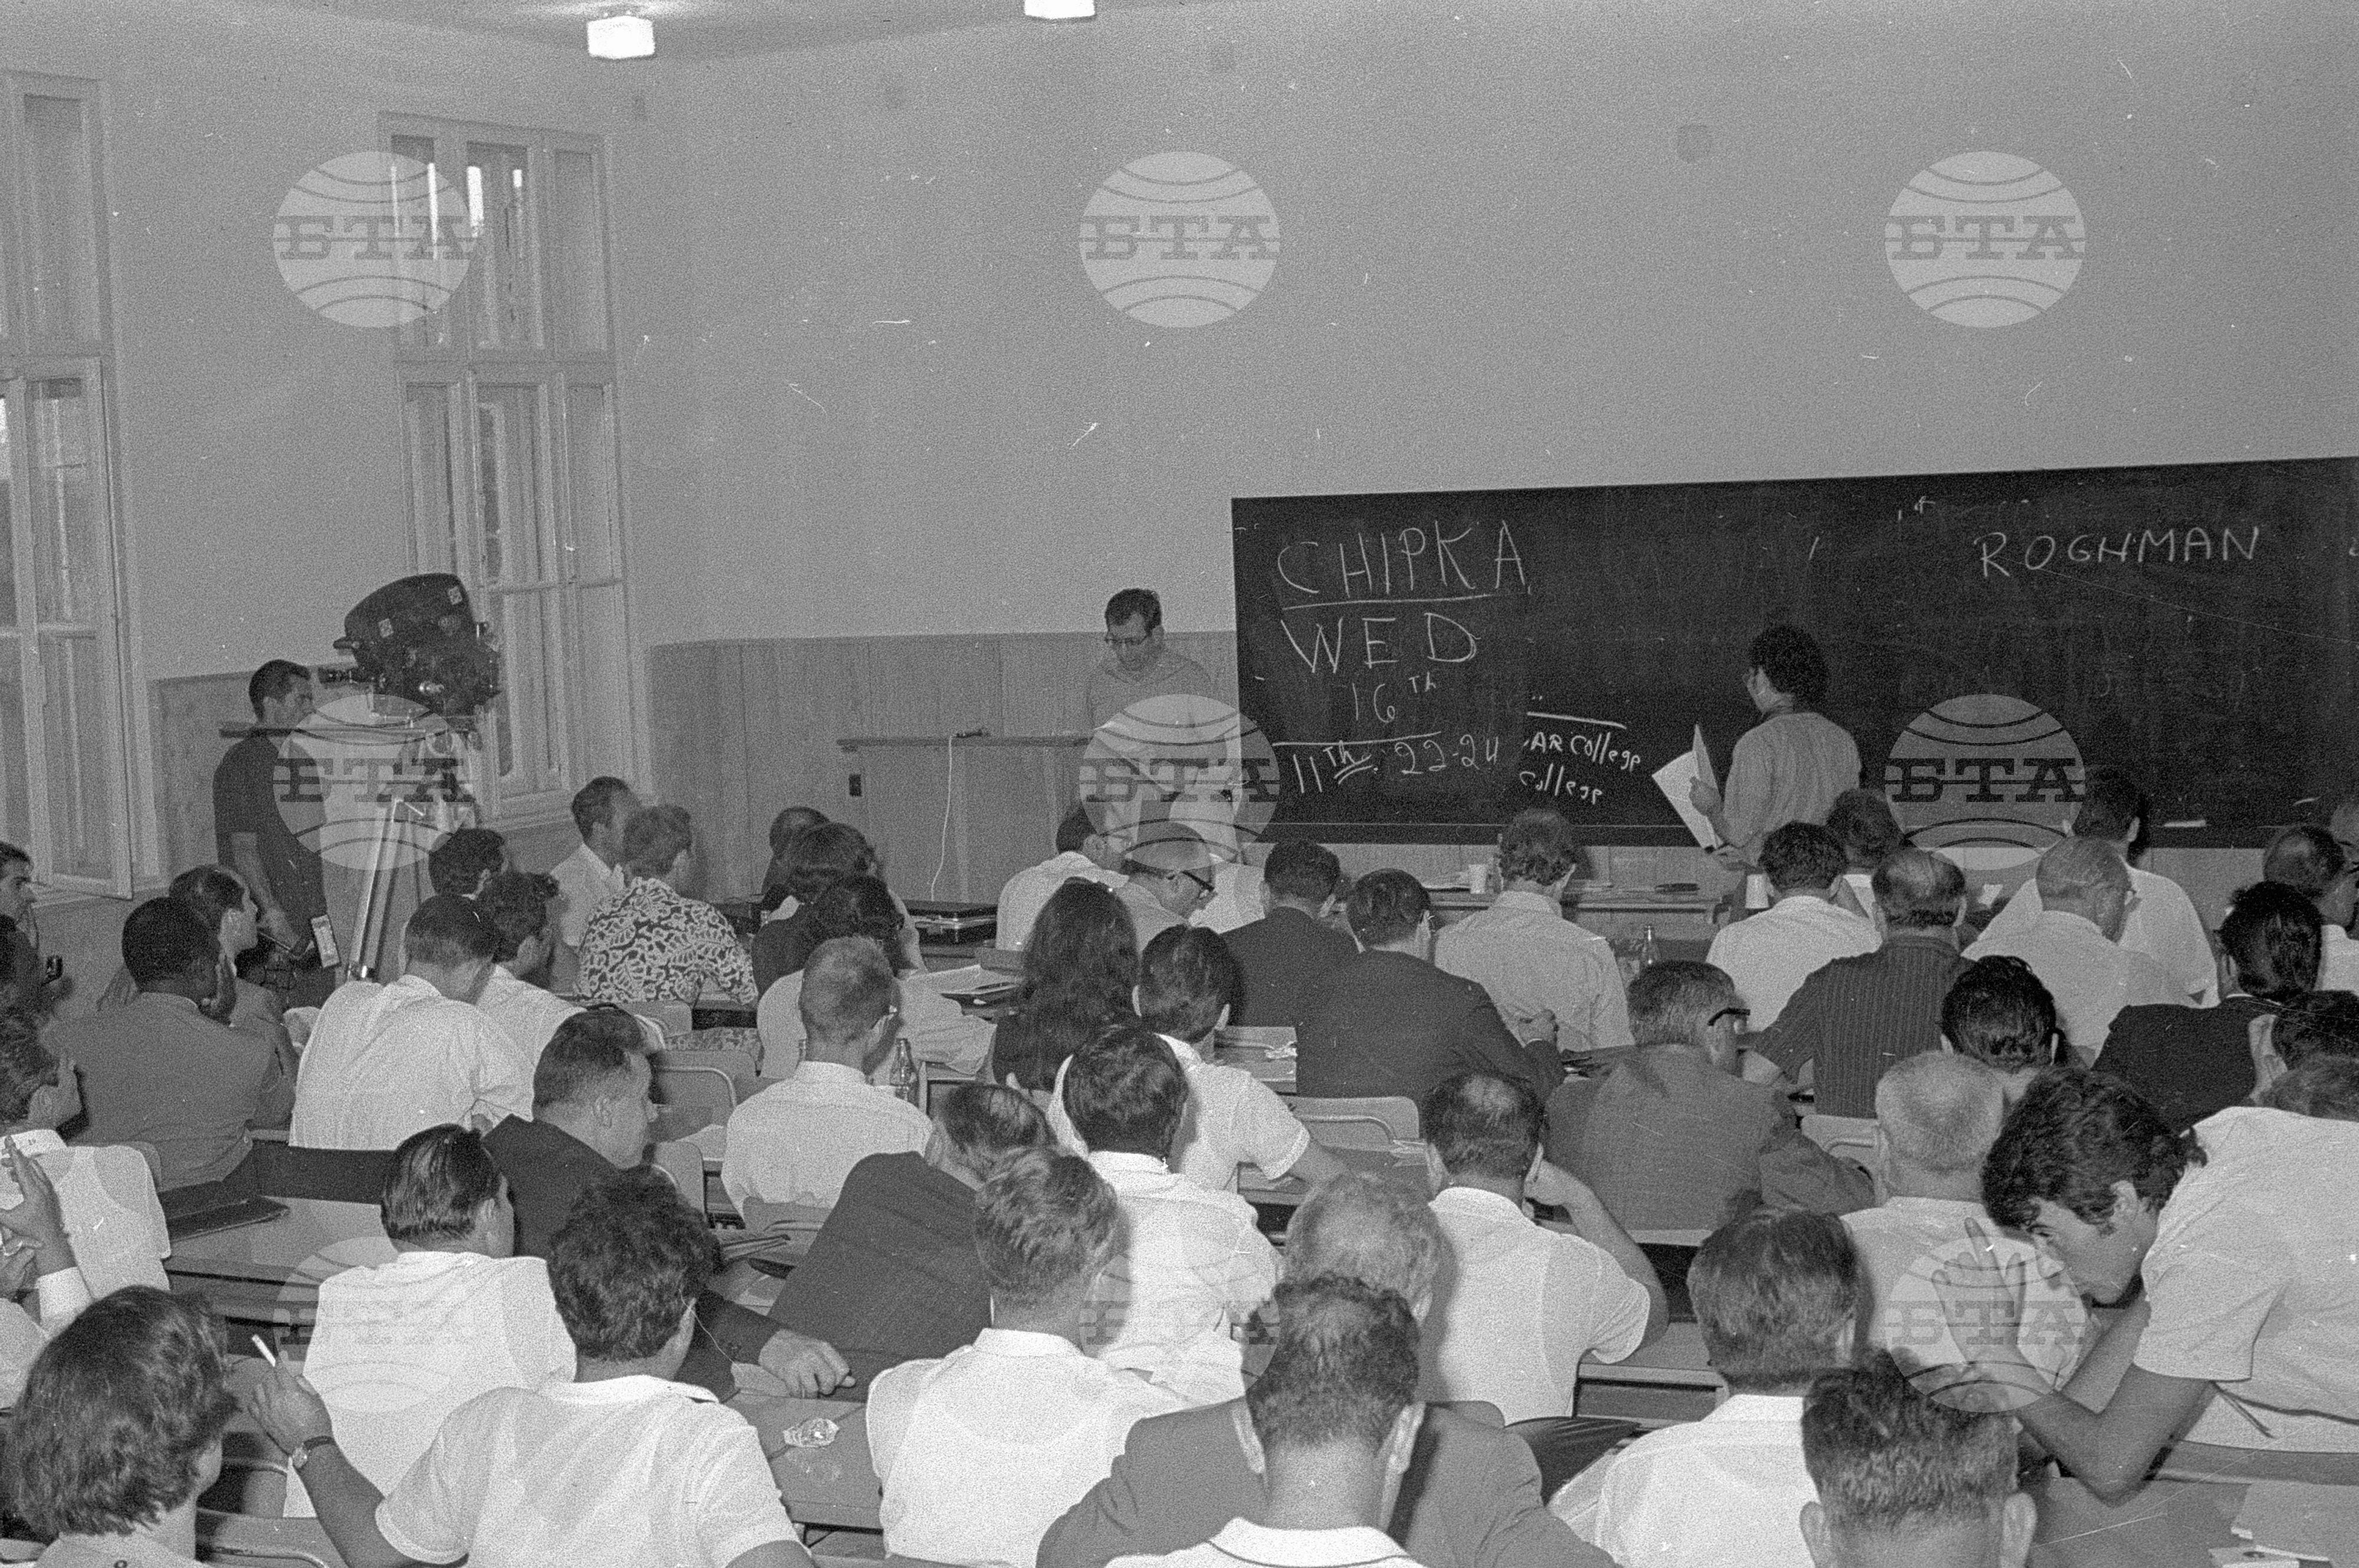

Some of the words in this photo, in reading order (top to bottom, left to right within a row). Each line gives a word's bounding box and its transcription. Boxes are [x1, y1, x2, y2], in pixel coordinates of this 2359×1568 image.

[1277, 520, 1525, 598] CHIPKA
[1973, 526, 2259, 577] ROGHMAN
[1280, 612, 1477, 673] WED
